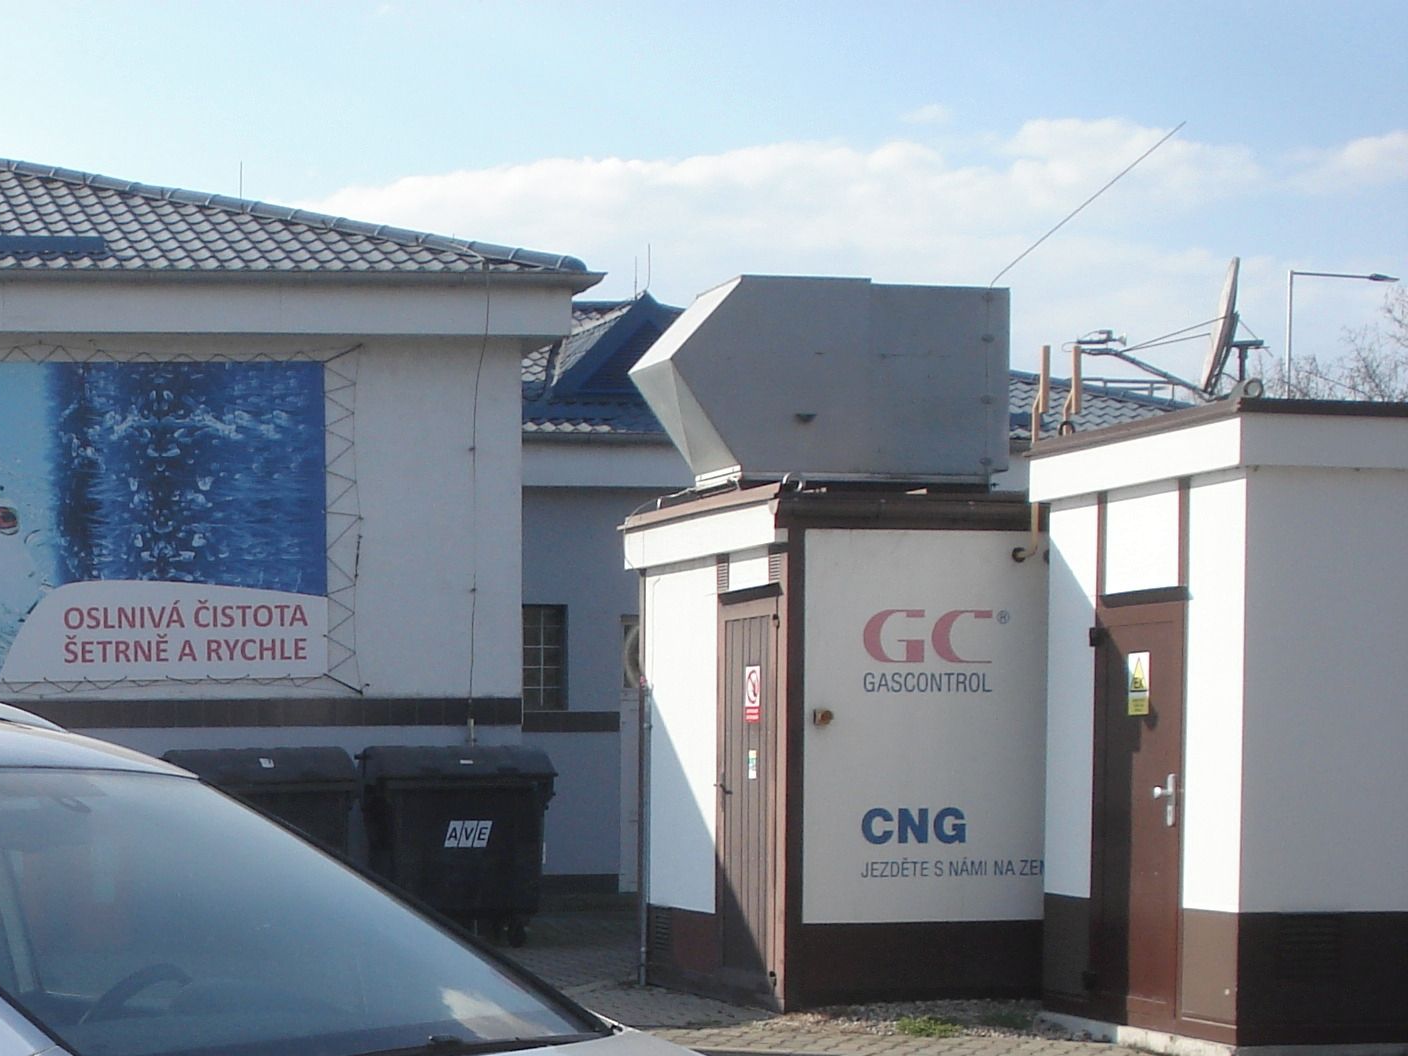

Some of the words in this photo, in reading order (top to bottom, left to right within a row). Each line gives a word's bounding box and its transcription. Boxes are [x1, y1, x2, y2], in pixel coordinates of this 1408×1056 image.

[63, 600, 185, 630] OSLNIVÁ
[193, 599, 308, 628] ČISTOTA
[63, 633, 169, 664] ŠETRNĚ
[178, 640, 198, 662] A
[206, 637, 308, 662] RYCHLE
[863, 672, 993, 693] GASCONTROL
[446, 826, 489, 842] AVE
[861, 807, 967, 845] CNG
[860, 857, 929, 878] JEZDĚTE
[934, 860, 944, 877] S
[949, 857, 988, 877] NÁMI
[994, 860, 1015, 876] NA
